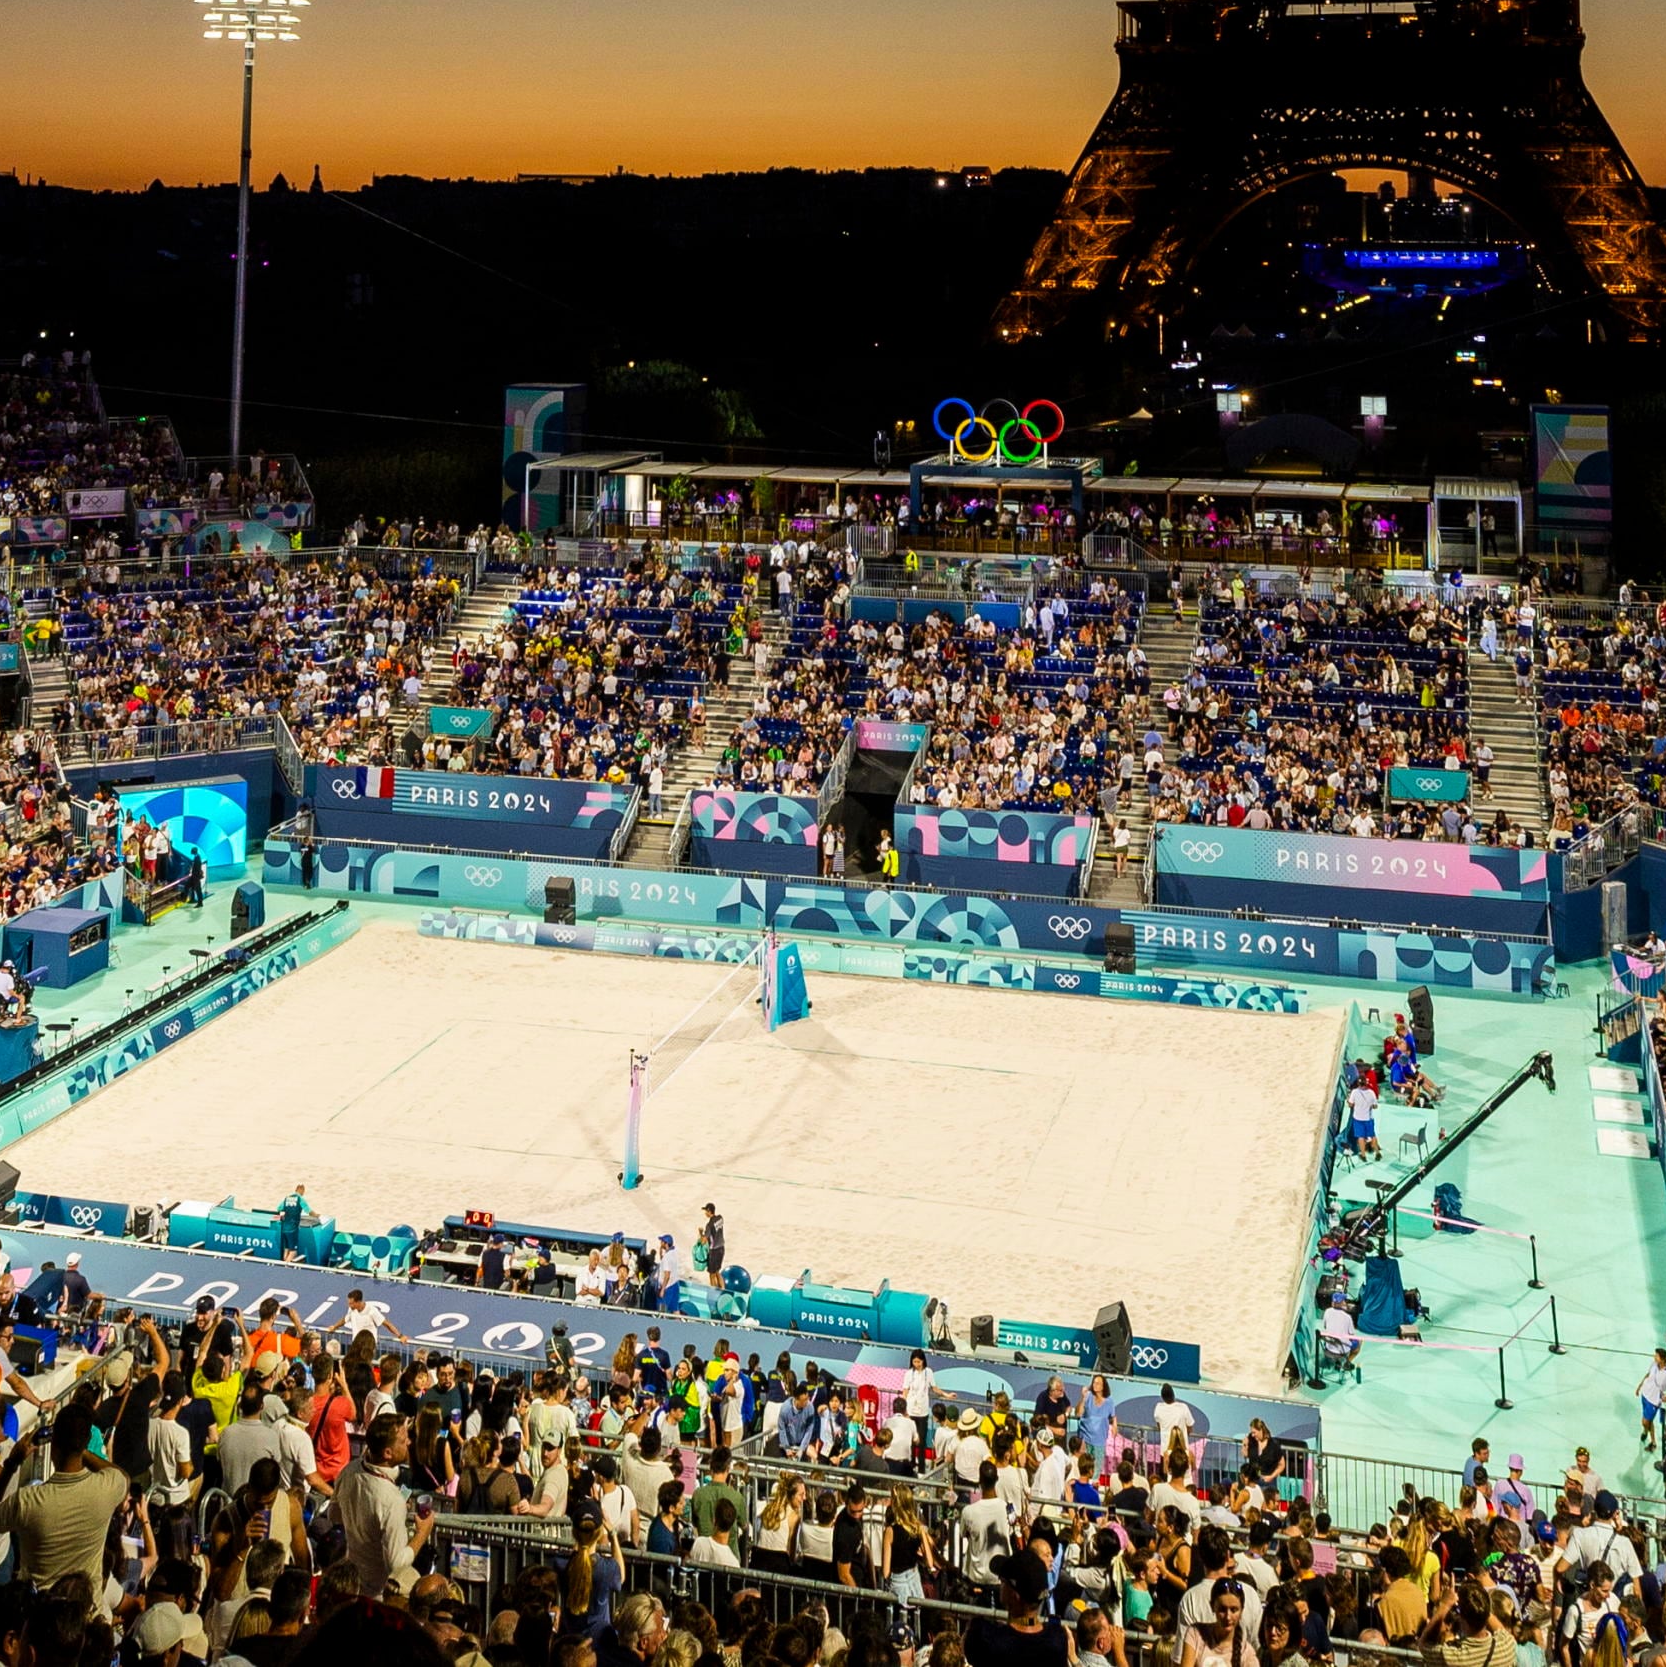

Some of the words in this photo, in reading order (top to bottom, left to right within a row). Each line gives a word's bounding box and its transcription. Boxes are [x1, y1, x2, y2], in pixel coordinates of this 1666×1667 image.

[411, 786, 479, 807] PARIS
[488, 791, 550, 813] 2024
[1277, 849, 1358, 873] PARIS
[1371, 856, 1446, 879] 2024
[629, 882, 696, 905] 2024
[1144, 925, 1227, 951] PARIS
[1239, 933, 1315, 958] 2024
[1105, 981, 1134, 991] PARIS
[1137, 984, 1163, 994] 2024
[214, 1233, 243, 1245] PARIS
[246, 1237, 273, 1249] 2024
[801, 1311, 835, 1325] PARIS
[838, 1316, 869, 1330] 2024
[414, 1312, 646, 1366] 202
[1006, 1333, 1048, 1349] PARIS
[1052, 1338, 1090, 1354] 2024
